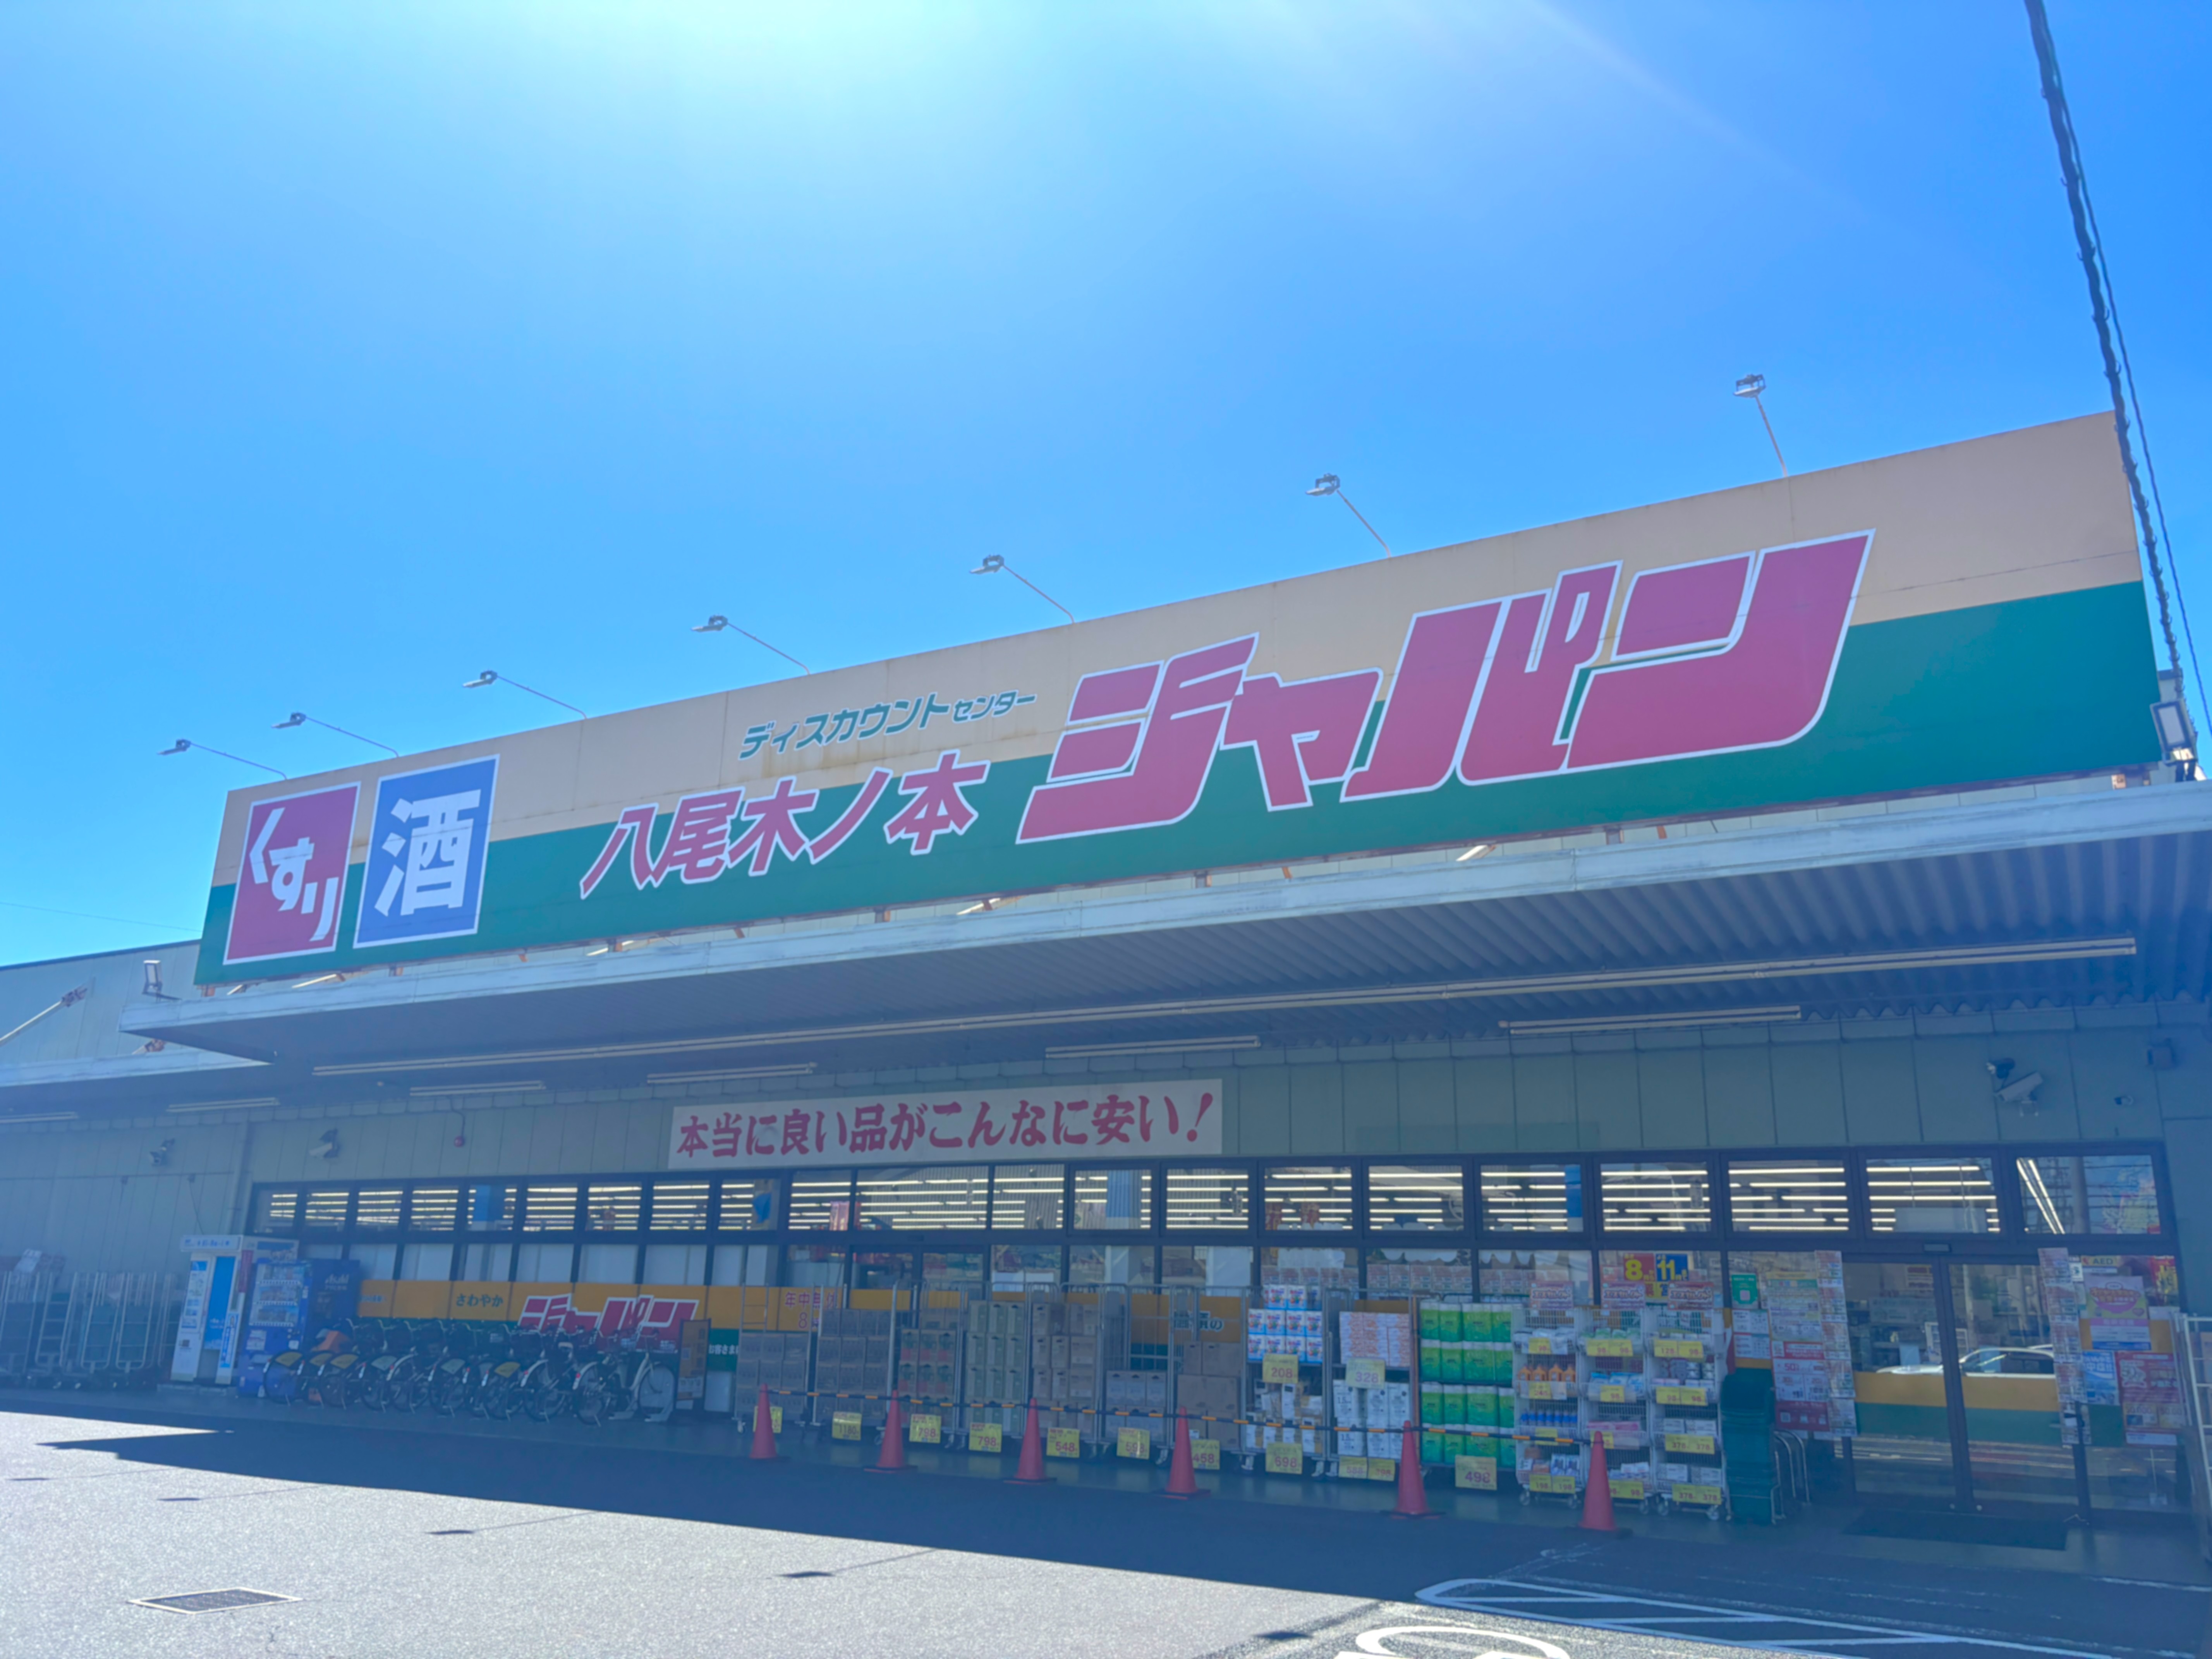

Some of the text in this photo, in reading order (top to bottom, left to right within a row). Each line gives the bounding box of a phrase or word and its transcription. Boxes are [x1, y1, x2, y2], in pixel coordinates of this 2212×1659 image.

[1015, 529, 1875, 844] ジャパン
[738, 689, 1037, 761] ディスカウントセンター
[580, 750, 991, 899] 八尾木ノ本
[374, 789, 481, 916] 酒
[249, 807, 338, 942] くすり
[1625, 1259, 1643, 1281] 8
[1657, 1259, 1675, 1280] 11
[456, 1293, 503, 1307] さわやか
[1271, 1367, 1293, 1378] 208
[1355, 1372, 1379, 1383] 328
[838, 1424, 857, 1435] 1180
[918, 1427, 936, 1438] 798
[977, 1436, 996, 1446] 798
[1055, 1441, 1075, 1452] 548
[1193, 1453, 1215, 1463] 458
[1275, 1456, 1298, 1468] 698
[1465, 1471, 1491, 1483] 498
